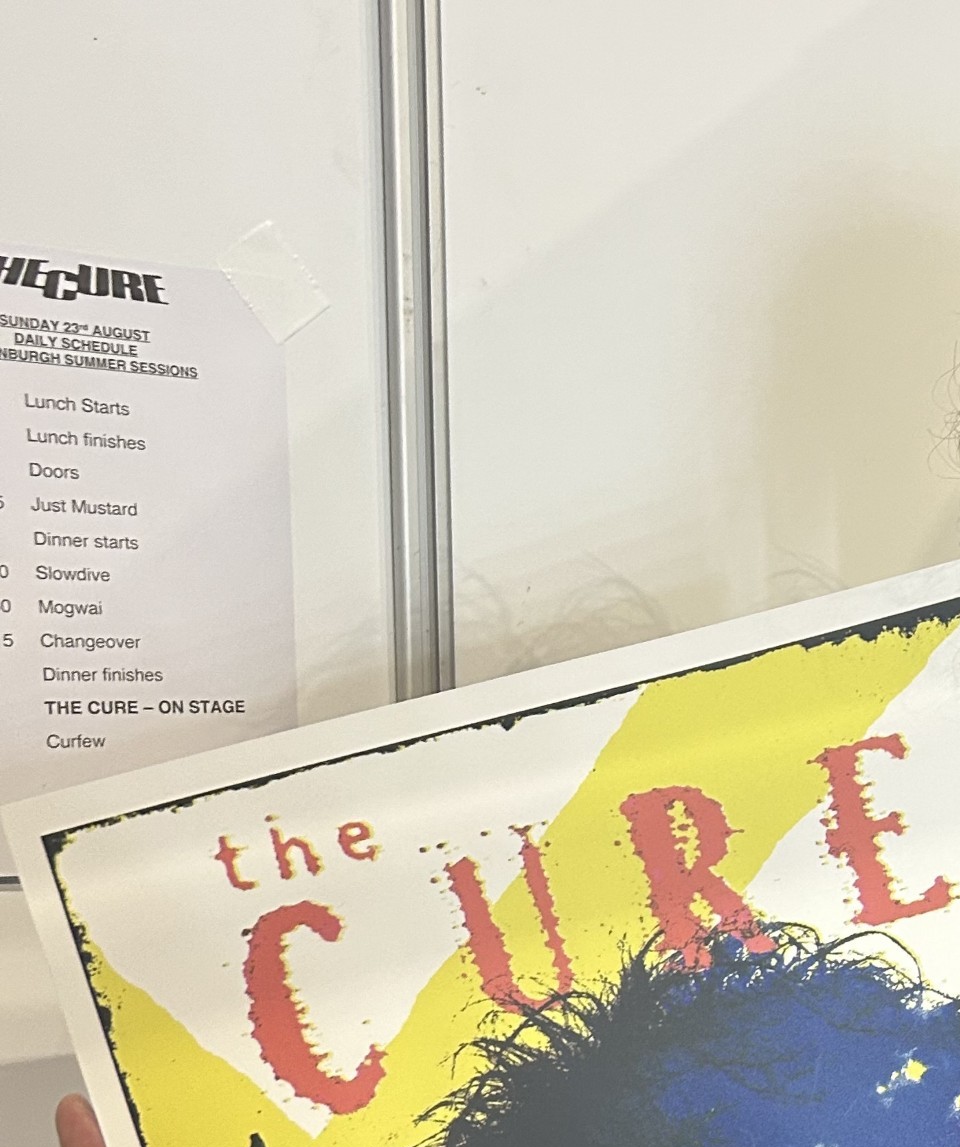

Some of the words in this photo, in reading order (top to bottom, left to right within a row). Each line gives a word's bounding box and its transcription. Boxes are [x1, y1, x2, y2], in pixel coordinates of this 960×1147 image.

[0, 315, 59, 332] SUNDAY
[93, 325, 150, 342] AUGUST
[14, 333, 57, 347] DAILY
[61, 337, 138, 356] SCHEDULE
[64, 354, 126, 371] SUMMER
[130, 361, 198, 378] SESSIONS
[24, 393, 76, 412] Lunch
[82, 398, 130, 416] Starts
[27, 428, 78, 446] Lunch
[83, 433, 146, 450] finishes
[29, 463, 79, 480] Doors
[31, 498, 67, 512] Just
[72, 499, 137, 516] Mustard
[34, 532, 88, 548] Dinner
[94, 536, 139, 550] starts
[36, 566, 110, 582] Slowdive
[38, 600, 102, 617] Mogwai
[40, 634, 141, 651] Changeover
[43, 668, 97, 682] Dinner
[103, 668, 163, 682] finishes
[44, 701, 82, 715] THE
[88, 701, 138, 714] CURE
[159, 701, 184, 714] ON
[189, 700, 245, 714] STAGE
[47, 734, 106, 749] Curfew
[213, 814, 381, 892] the
[241, 733, 960, 1115] CURE
